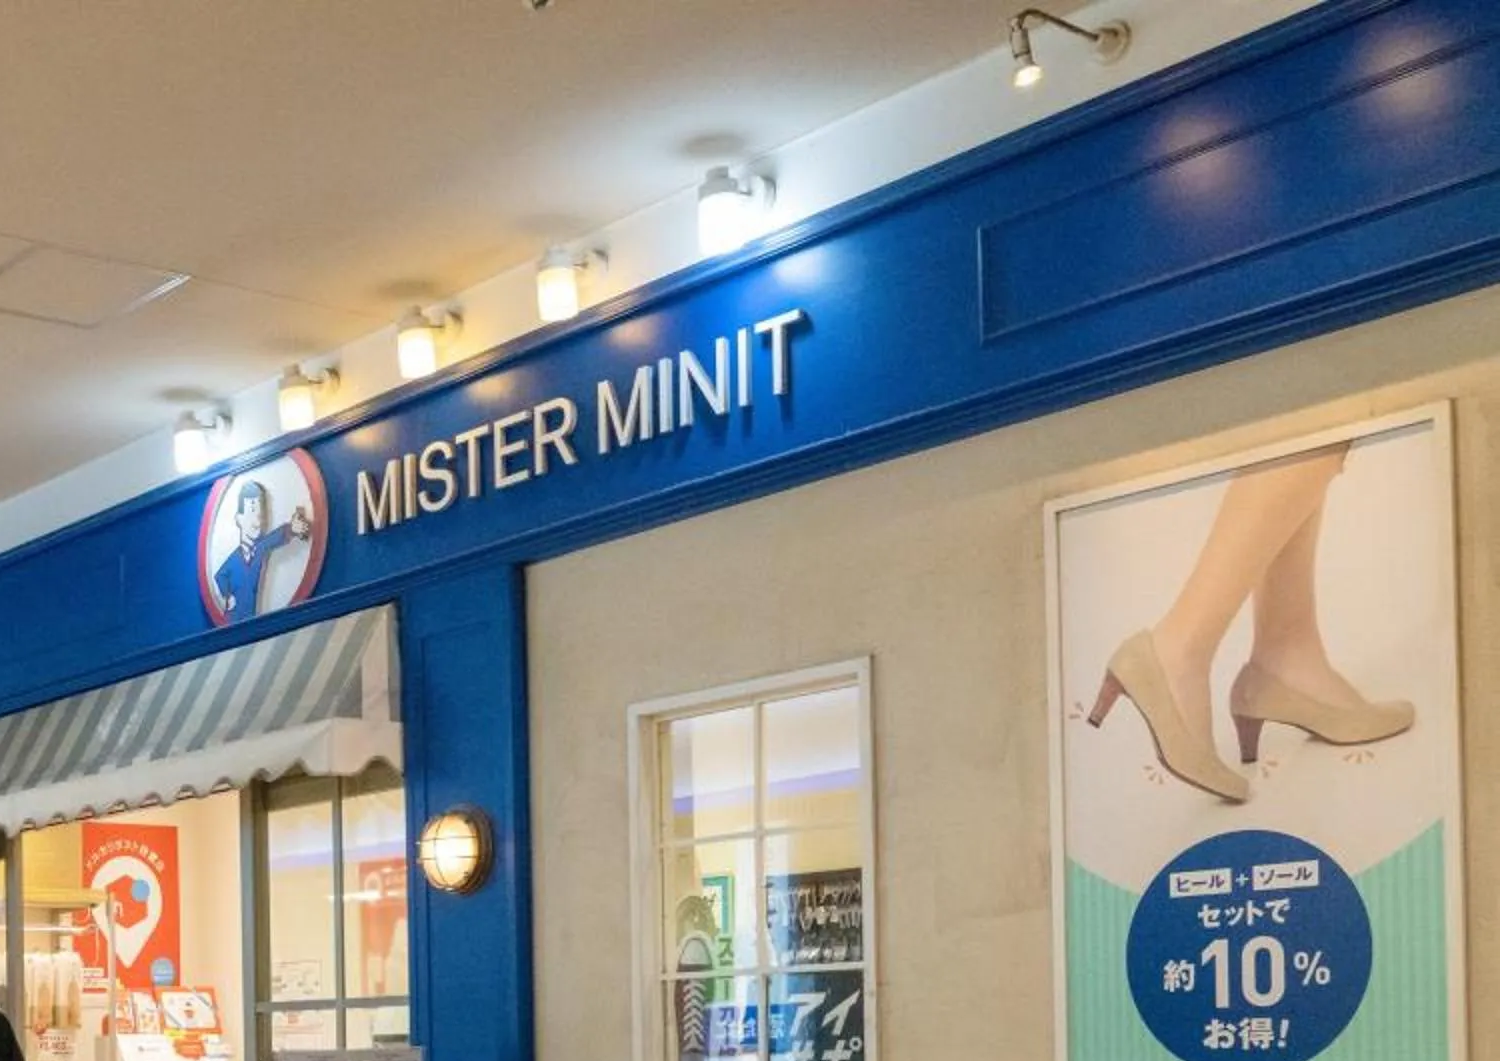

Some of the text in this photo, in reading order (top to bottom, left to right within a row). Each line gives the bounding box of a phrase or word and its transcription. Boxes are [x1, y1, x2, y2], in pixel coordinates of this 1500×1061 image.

[356, 309, 808, 536] MISTER MINIT
[1176, 873, 1226, 892] ヒール
[1259, 866, 1313, 885] ソール
[1198, 898, 1291, 928] セットで
[1162, 935, 1331, 1009] 約10%
[788, 988, 862, 1037] アイ
[1202, 1017, 1290, 1051] お得!
